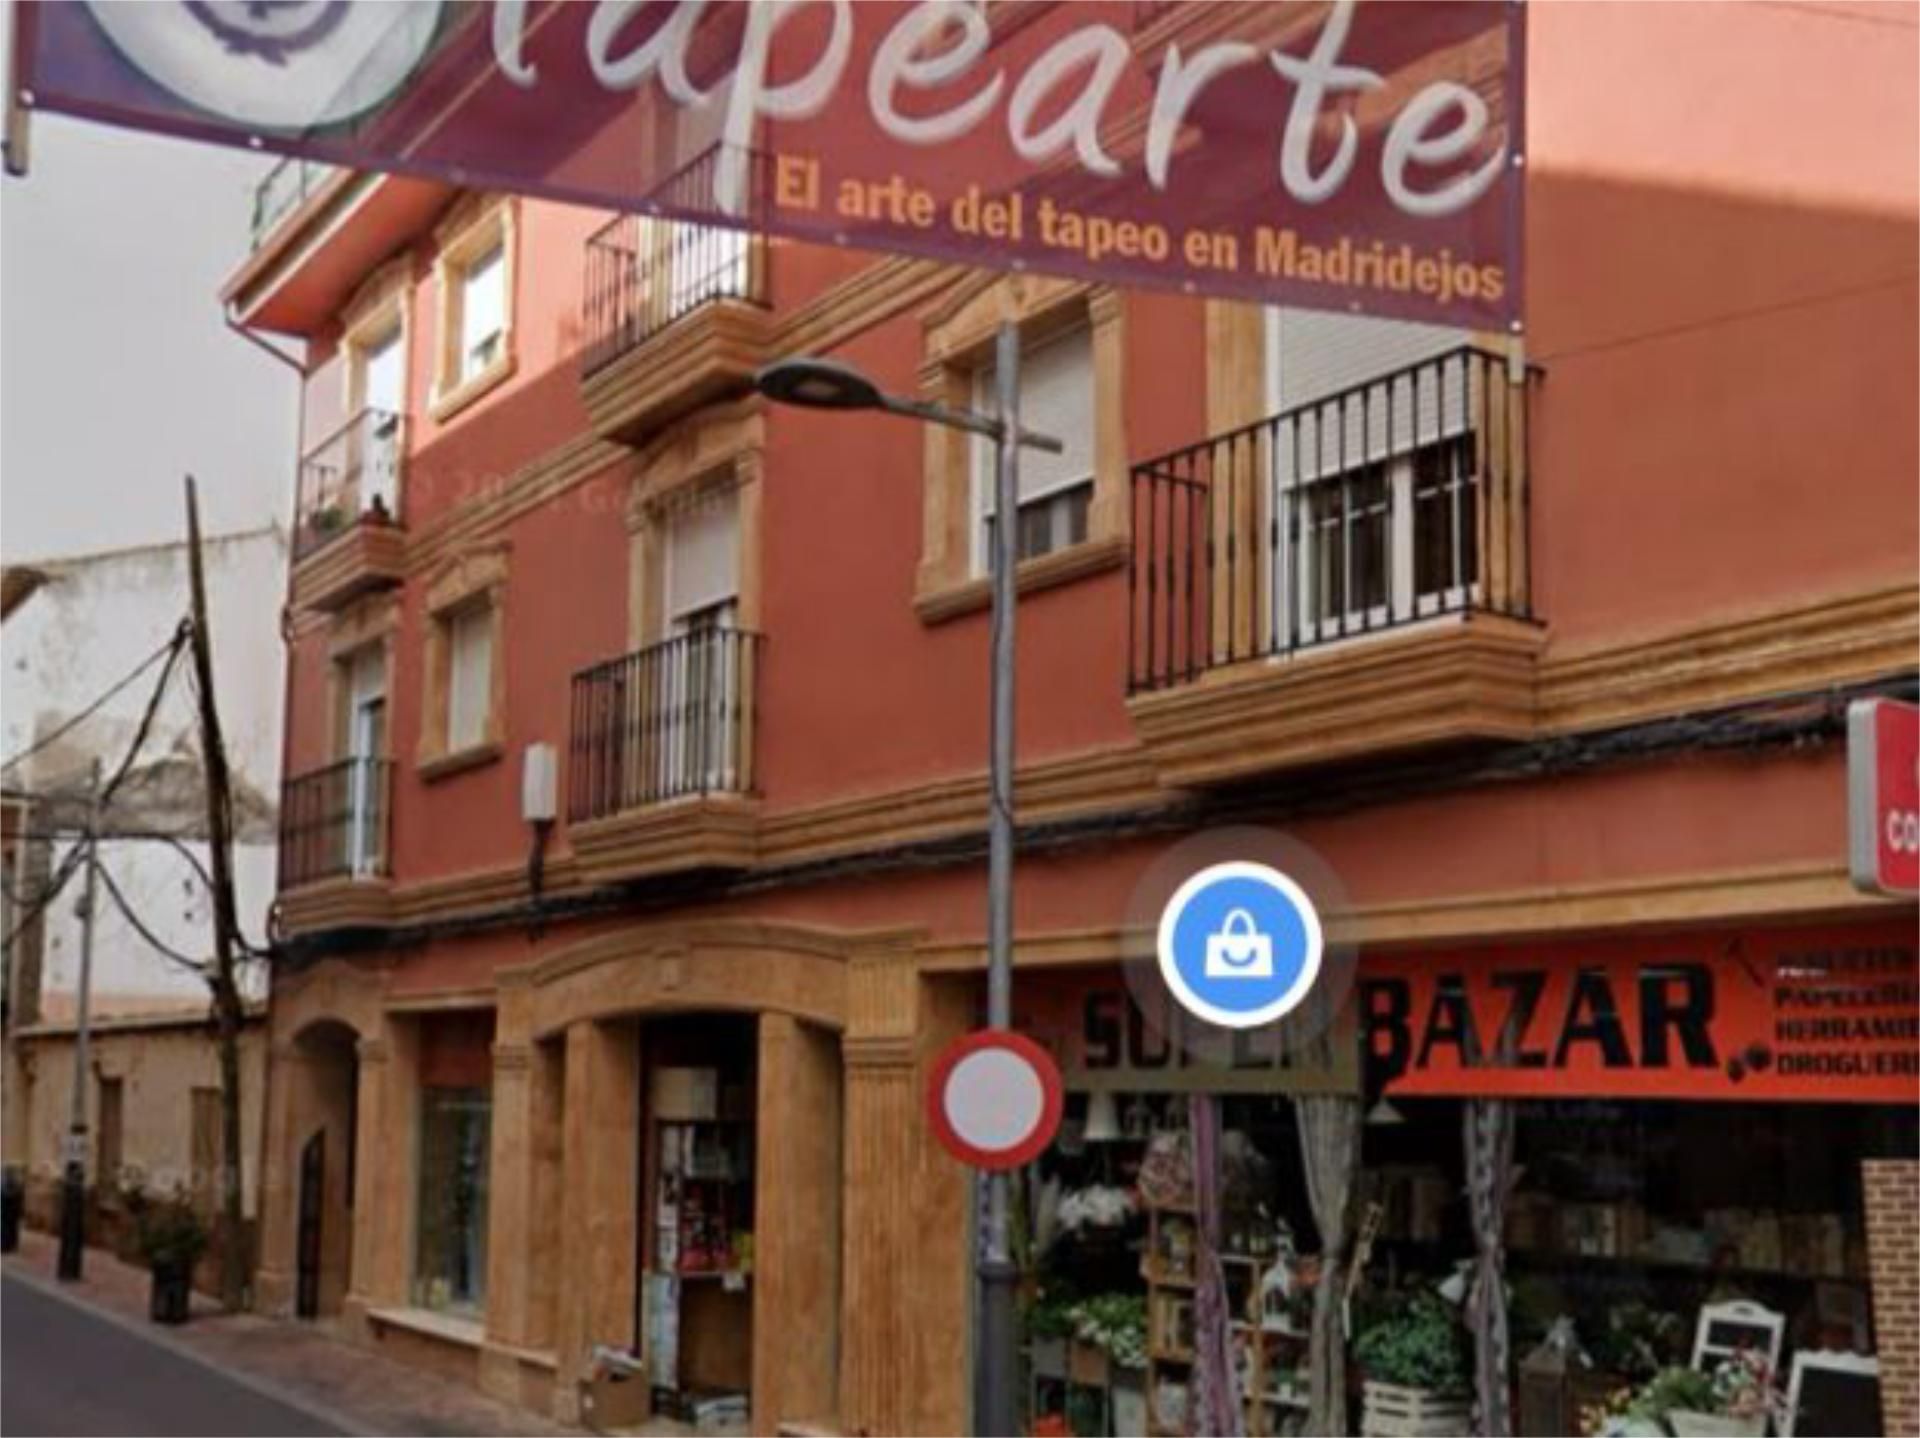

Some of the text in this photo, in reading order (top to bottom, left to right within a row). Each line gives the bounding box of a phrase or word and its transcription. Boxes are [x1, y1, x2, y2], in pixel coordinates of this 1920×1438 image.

[775, 155, 1505, 303] El arte del tapeo en Madridejos
[1359, 963, 1720, 1077] BAZAR
